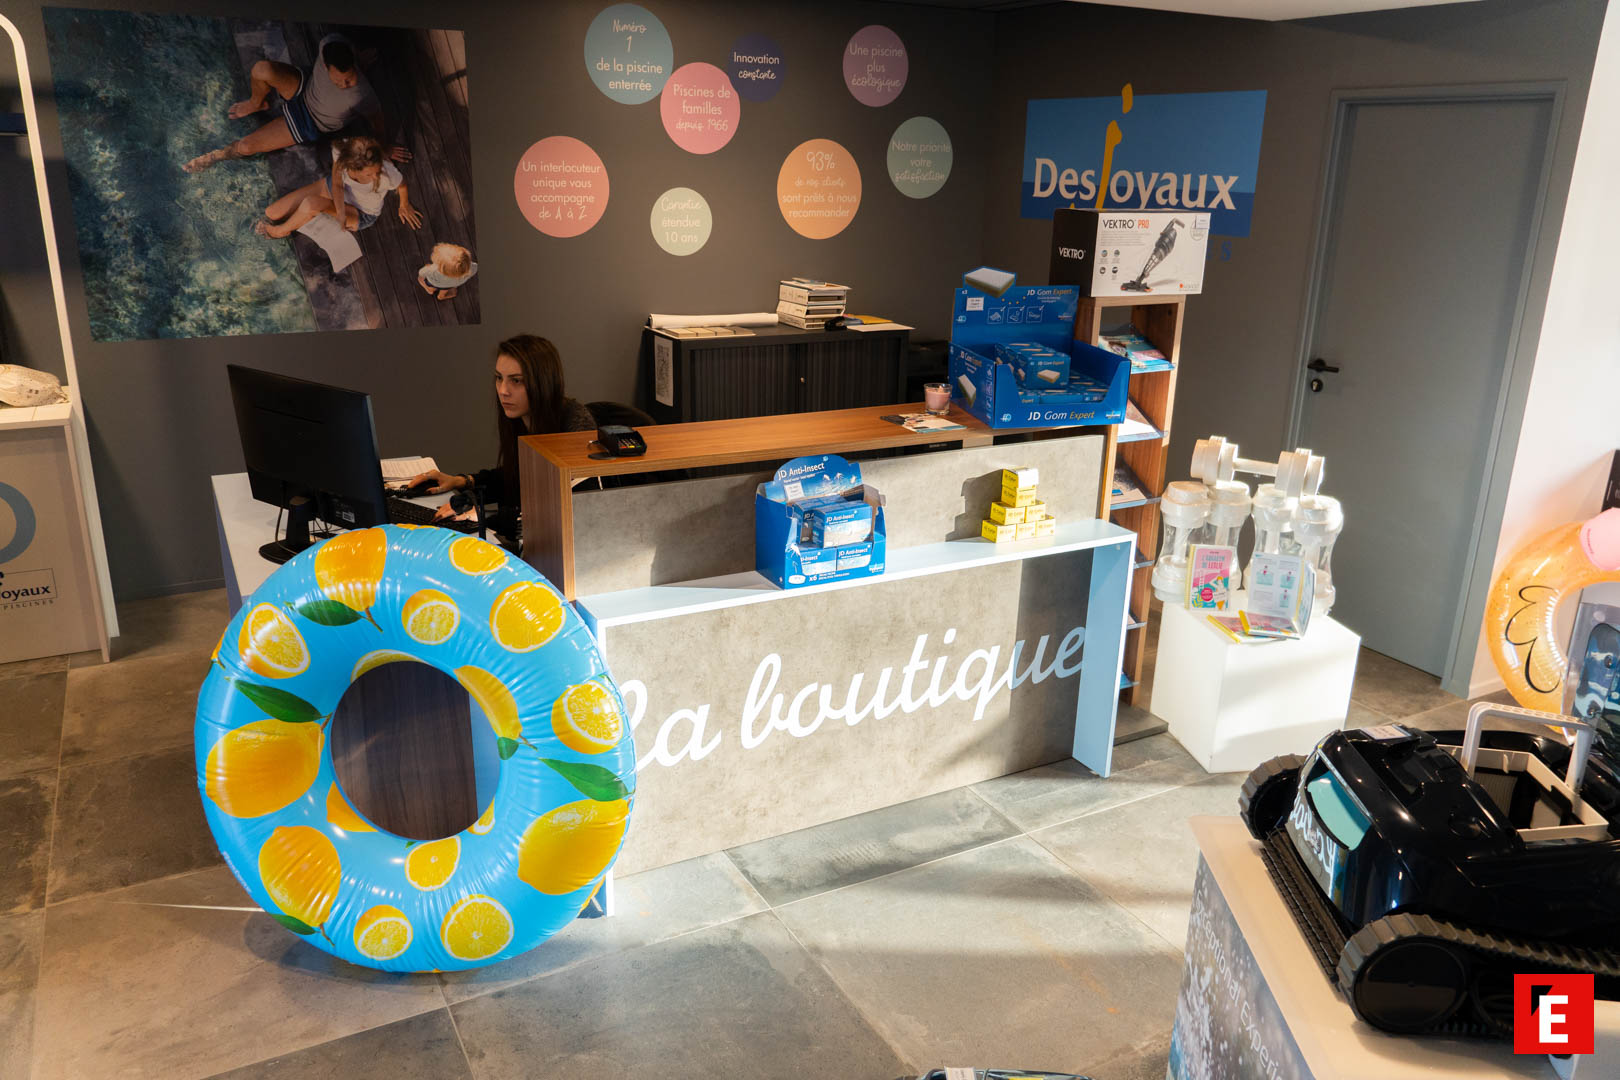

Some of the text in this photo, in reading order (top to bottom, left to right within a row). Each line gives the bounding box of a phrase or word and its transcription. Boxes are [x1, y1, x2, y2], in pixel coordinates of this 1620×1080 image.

[612, 19, 647, 34] Numéro
[626, 35, 633, 53] 1
[850, 43, 904, 58] Une piscine
[733, 52, 780, 65] Innovation
[596, 57, 663, 76] de la piscine
[866, 60, 886, 75] plus
[738, 69, 777, 81] constante
[608, 78, 652, 92] enterrée
[851, 75, 902, 92] écologique
[673, 84, 731, 99] Piscines de
[682, 100, 723, 115] familles
[675, 120, 729, 132] depuis 1966
[892, 141, 917, 153] Notre
[1032, 83, 1240, 212] Desjoyaux
[522, 161, 602, 174] Un interlocuteur
[806, 151, 836, 171] 93%
[910, 158, 932, 168] votre
[532, 177, 592, 190] unique vous
[895, 171, 946, 184] satisfaction
[530, 194, 595, 206] accompagne
[782, 193, 801, 204] sont
[827, 193, 834, 203] à
[836, 194, 857, 203] nous
[538, 205, 588, 221] de A à Z
[789, 207, 850, 218] recommander
[661, 216, 701, 228] étendue
[1102, 219, 1150, 229] VEKTRO PRO
[665, 231, 698, 243] 10 ans
[1058, 247, 1085, 260] VEKTRO
[1053, 288, 1073, 296] Expert
[1027, 411, 1041, 421] JD
[1044, 410, 1068, 421] Gom
[1069, 411, 1095, 421] Expert
[777, 470, 787, 480] JD
[789, 462, 825, 477] Anti-Insect
[3, 599, 55, 611] PISCINES
[740, 626, 1087, 750] boutique
